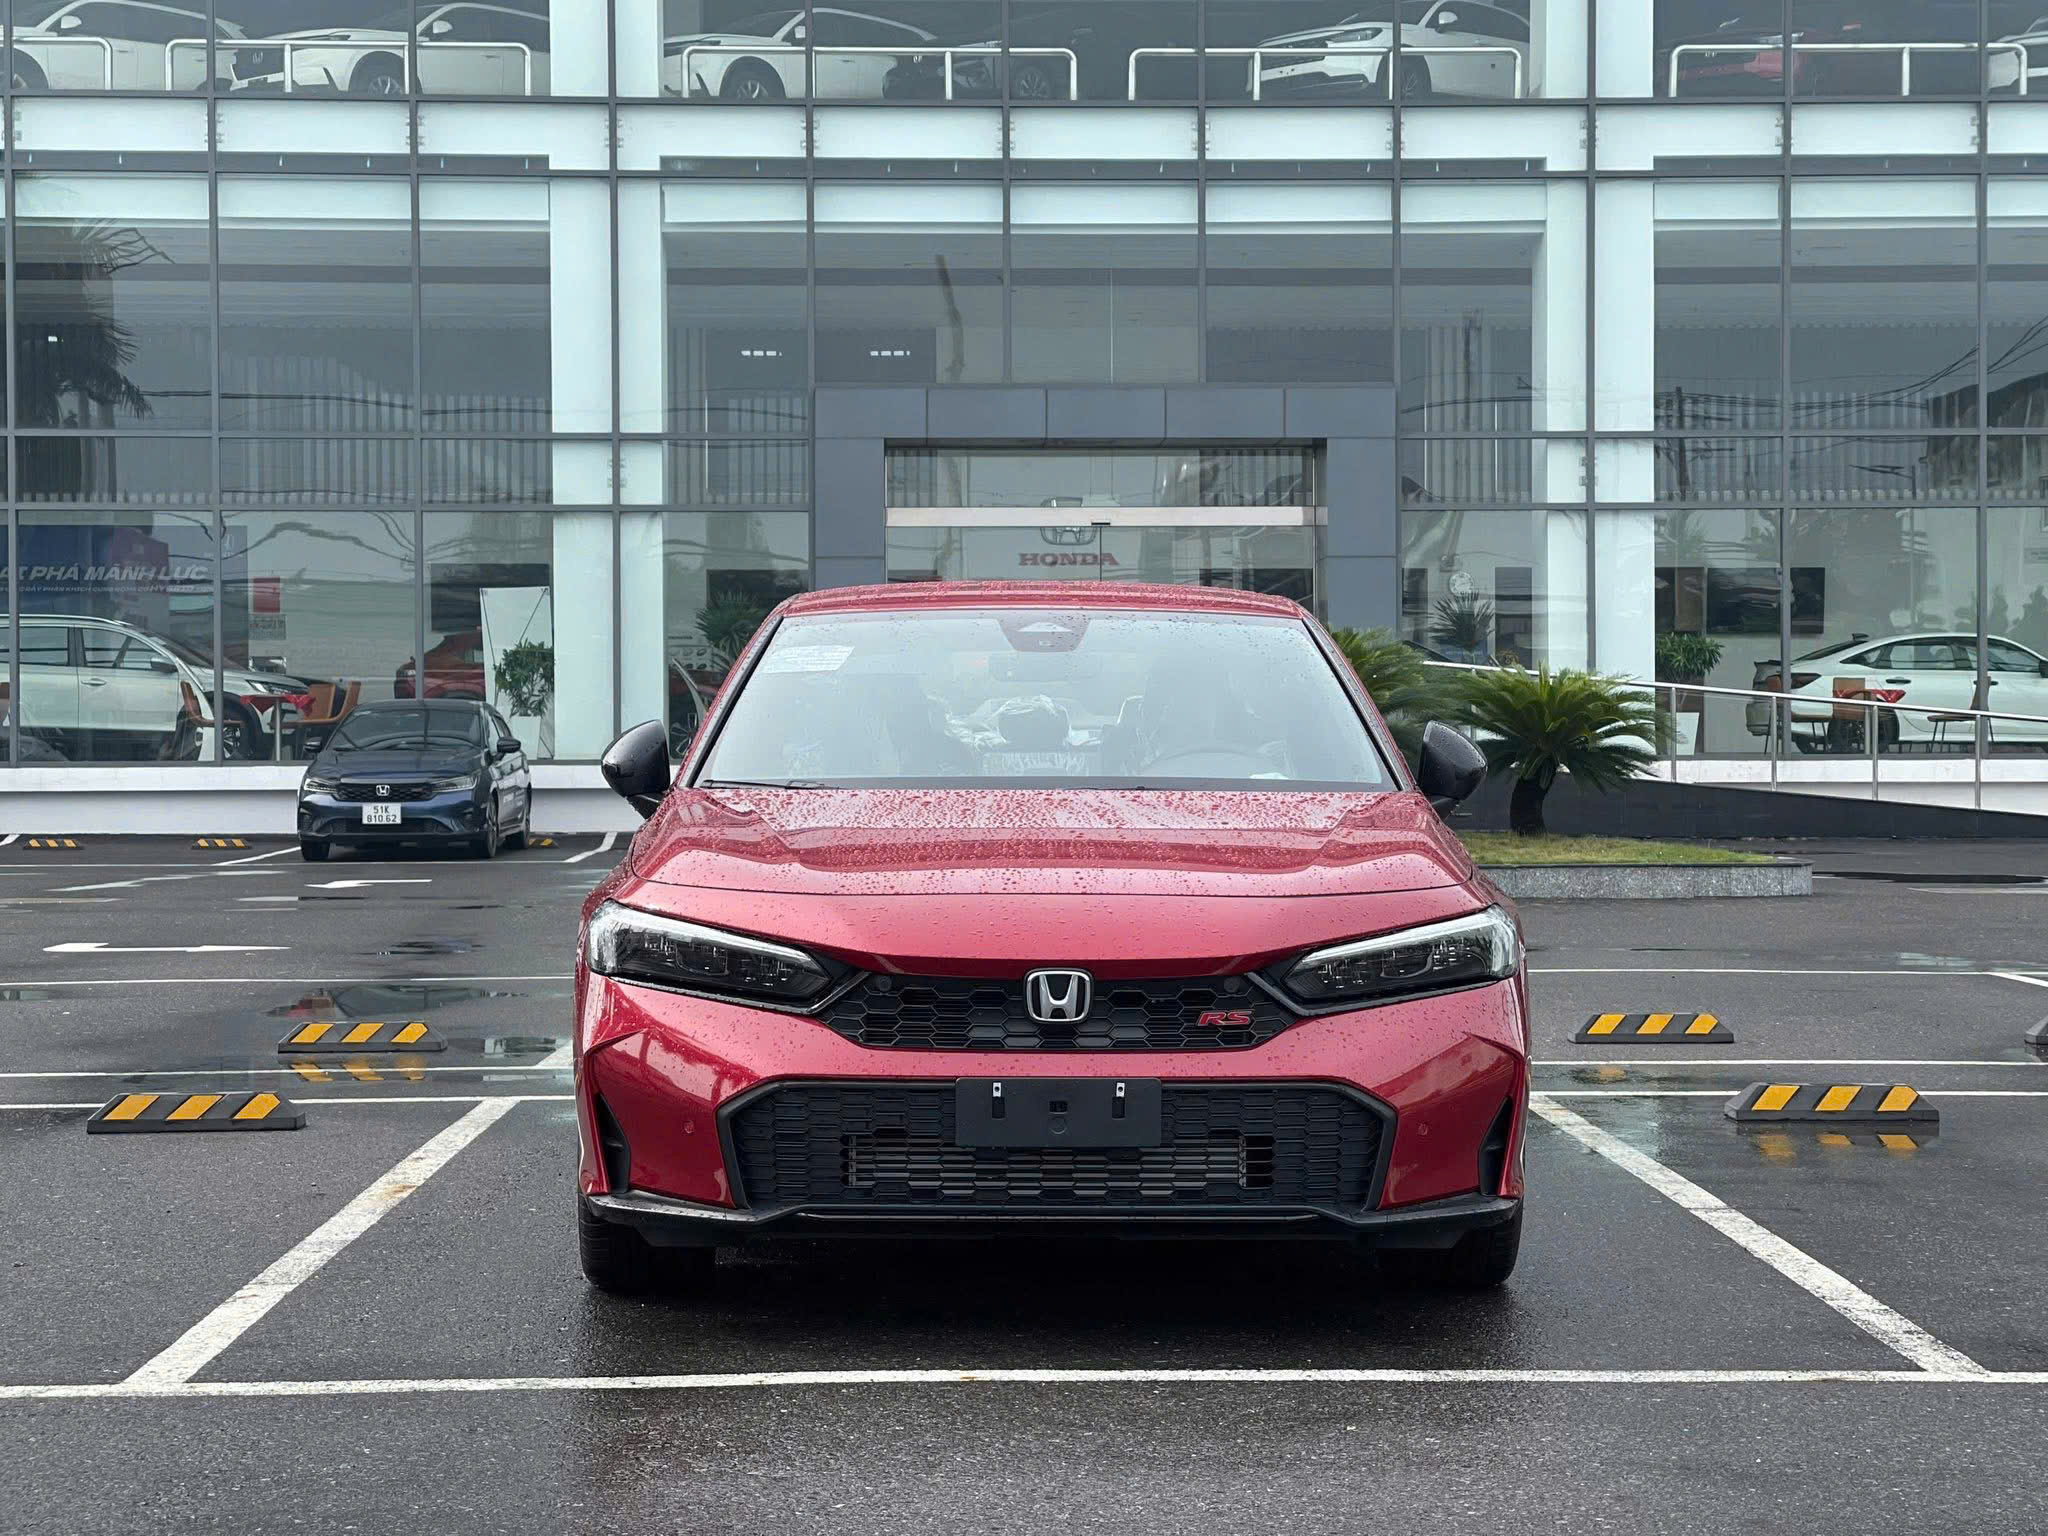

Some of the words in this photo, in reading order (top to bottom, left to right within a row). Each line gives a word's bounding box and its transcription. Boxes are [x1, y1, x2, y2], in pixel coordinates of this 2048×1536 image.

[1018, 552, 1119, 567] HONDA
[31, 563, 80, 581] PHÁ
[373, 805, 390, 814] 51K
[1198, 1010, 1252, 1026] RS
